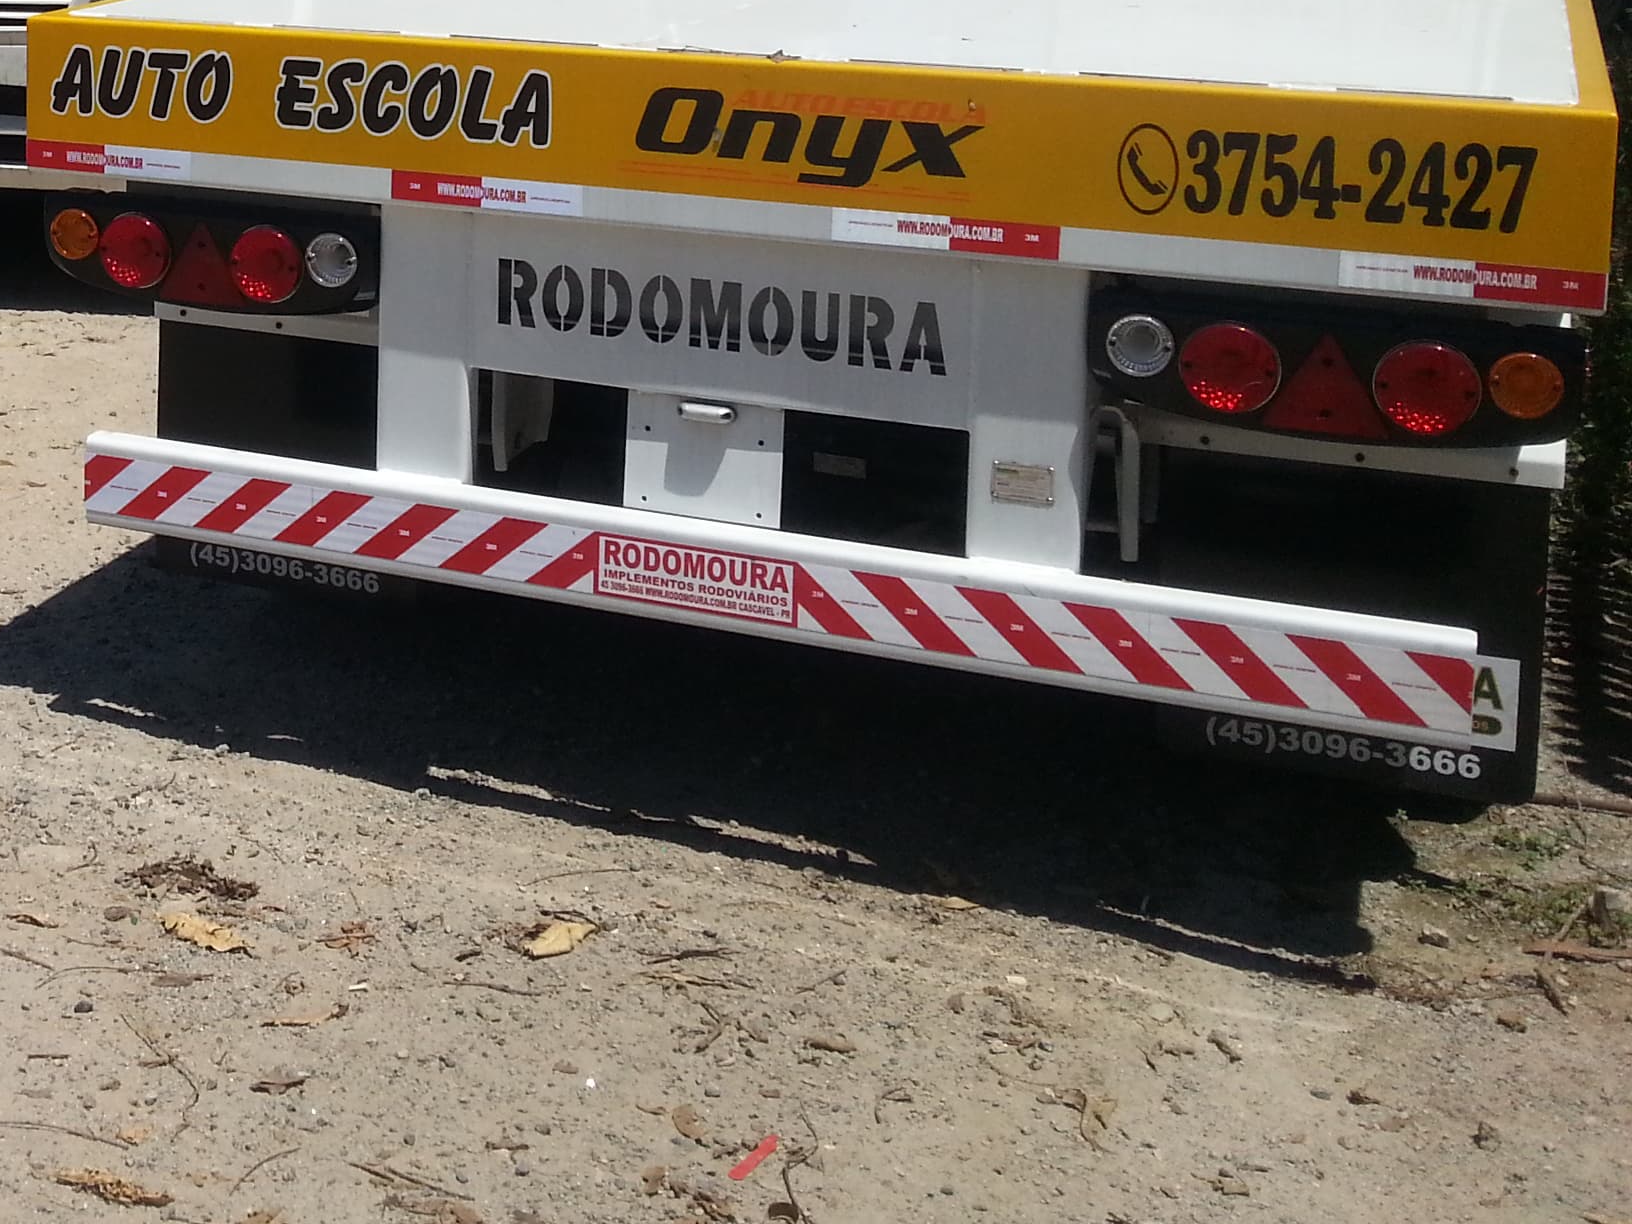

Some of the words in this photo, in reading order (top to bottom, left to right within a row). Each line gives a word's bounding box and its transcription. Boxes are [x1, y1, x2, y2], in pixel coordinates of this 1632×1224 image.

[51, 45, 232, 122] AUTO
[276, 57, 552, 147] ESCOLA
[732, 89, 835, 115] AUTO
[838, 97, 985, 124] ESCOLA
[635, 87, 984, 188] Onyx
[437, 182, 526, 203] WWW.RODOMOURA.COM.BR
[1184, 129, 1539, 233] 3754-2427
[897, 219, 1004, 243] WWW.RODOMOURA.COM.BR
[1413, 265, 1537, 291] WWW.RODOMOURA.COM.BR
[498, 257, 947, 376] RODOMOURA
[190, 542, 380, 594] (45)3096-3666
[604, 540, 789, 594] RODOMOURA
[604, 569, 694, 592] IMPLEMENTOS
[698, 584, 788, 607] RODOVIÁRIOS
[645, 587, 737, 610] WWW.RODOMOURA.COM.BR
[739, 602, 775, 617] CASCAVEL
[781, 609, 790, 619] PR
[1206, 717, 1481, 779] (45)3096-3666
